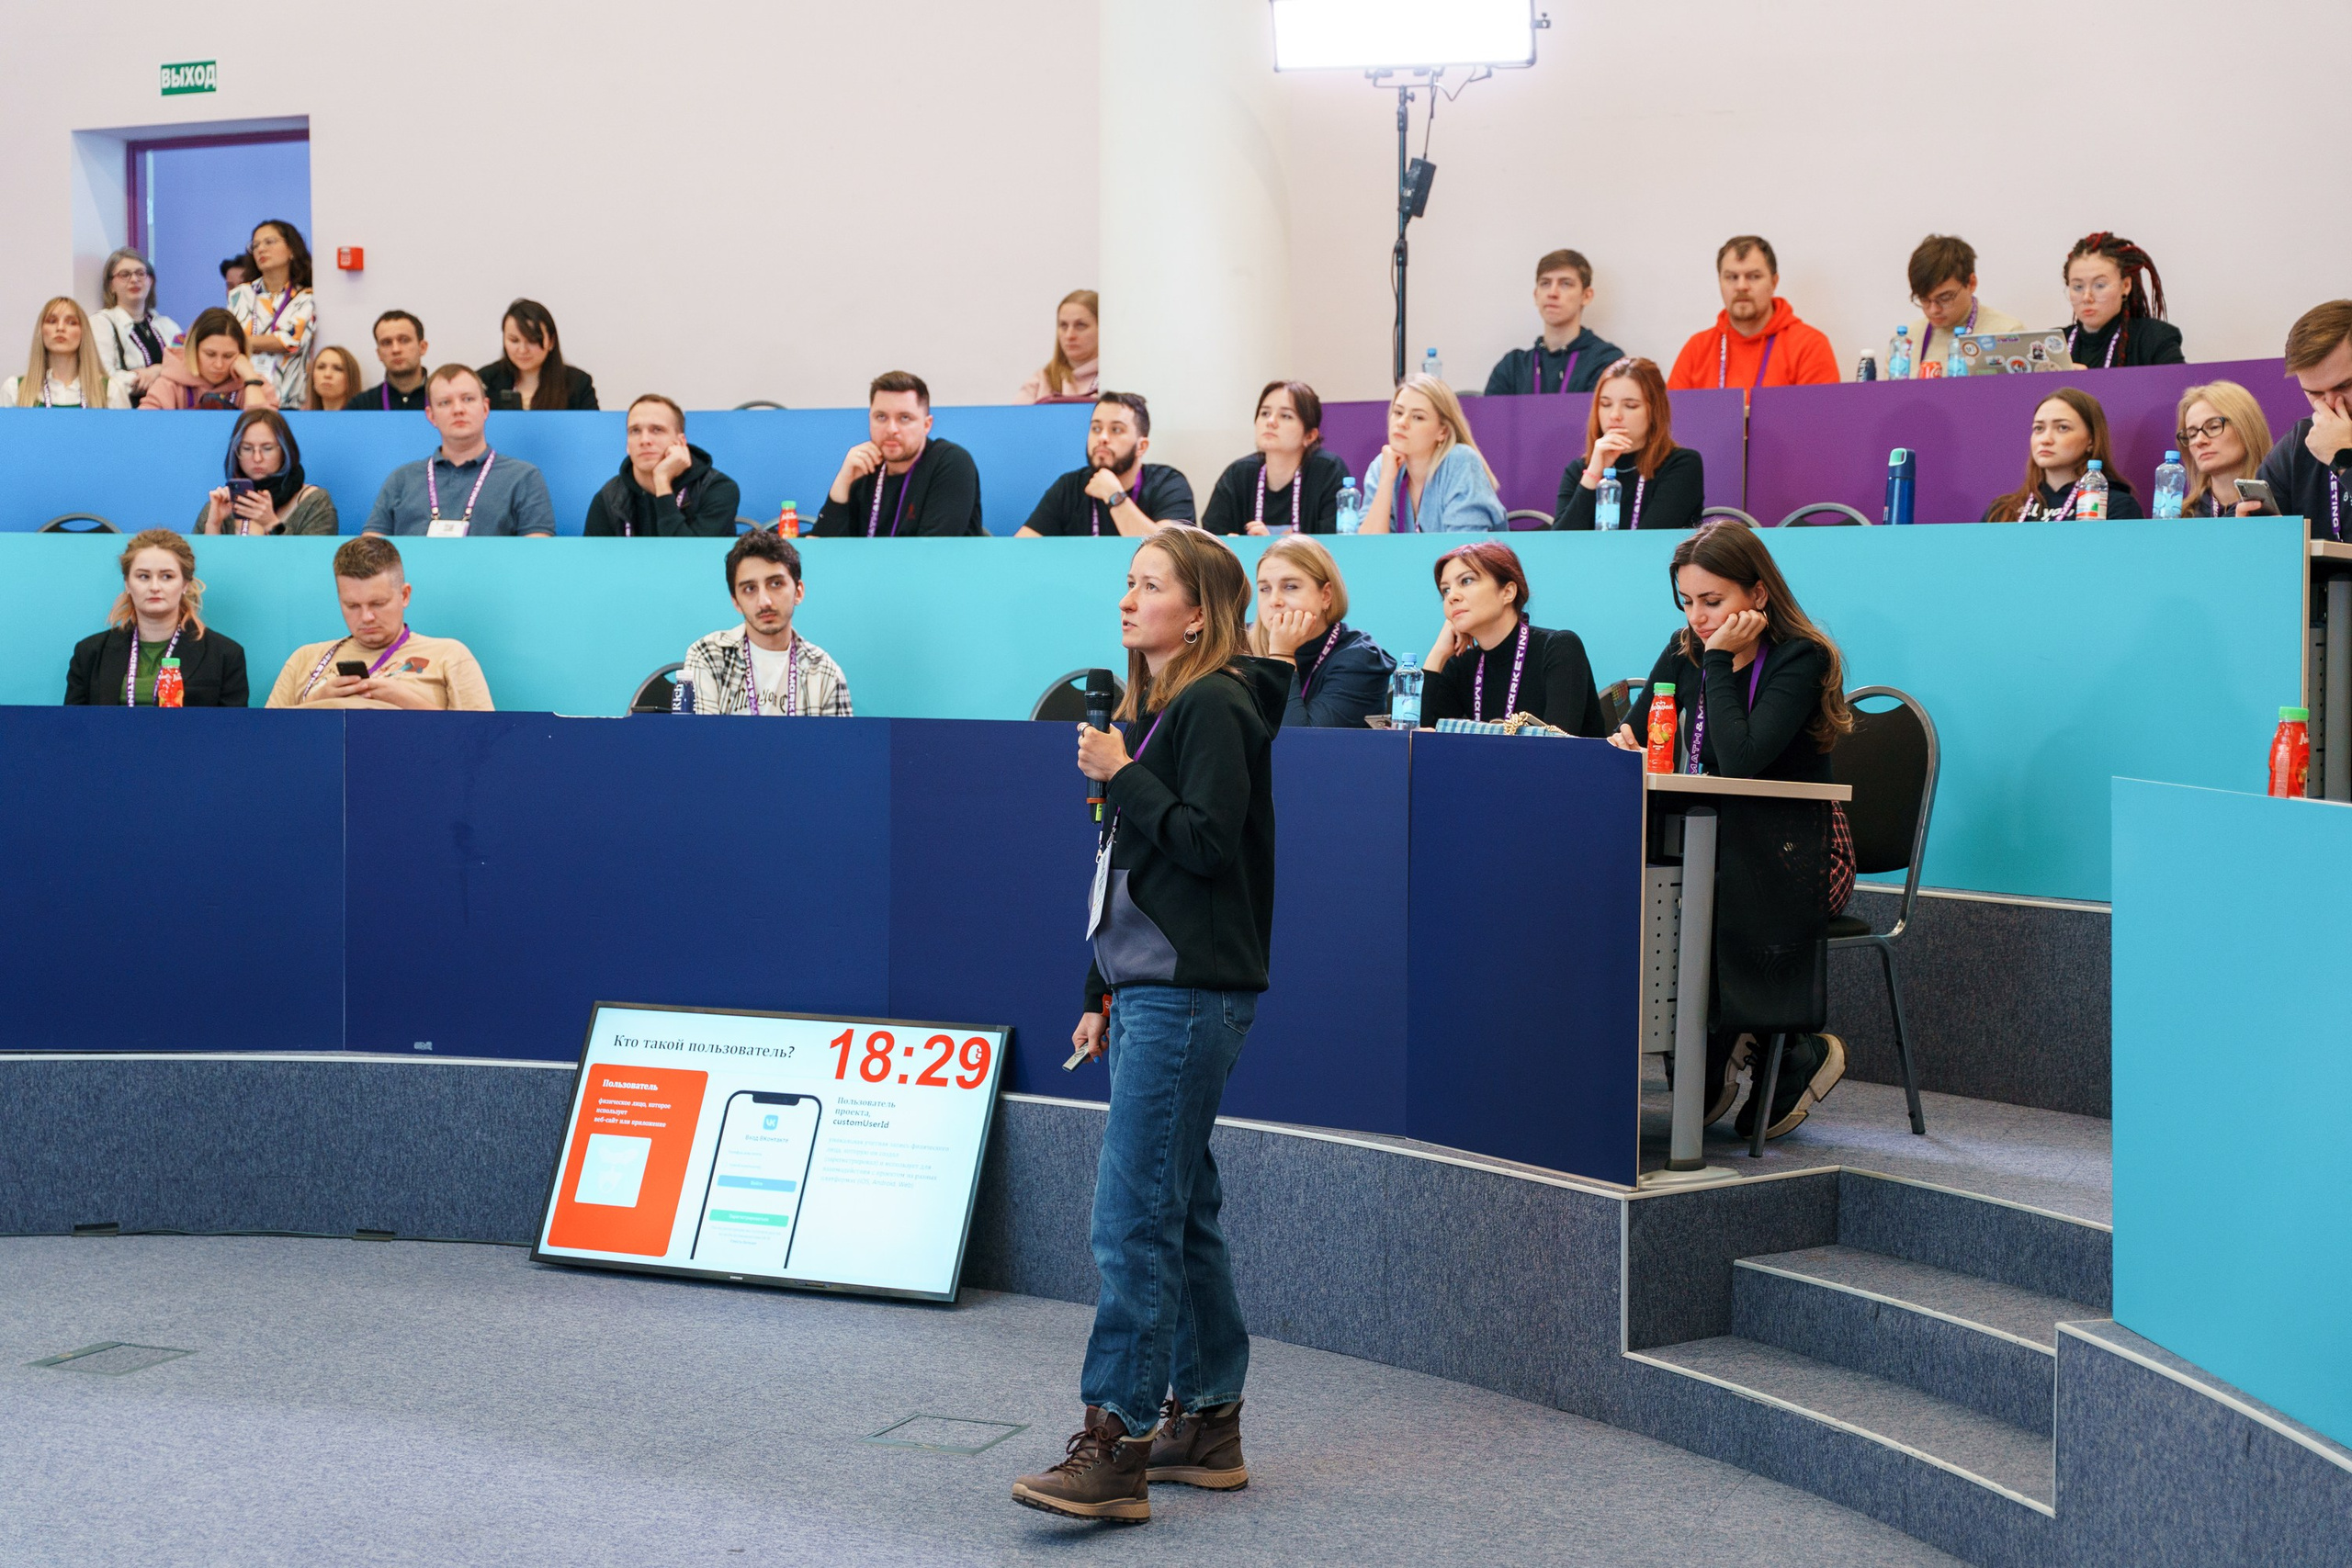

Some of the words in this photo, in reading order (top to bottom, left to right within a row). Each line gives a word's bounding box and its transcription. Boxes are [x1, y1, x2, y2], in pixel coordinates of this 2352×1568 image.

[161, 64, 216, 89] ВЫХОД
[1505, 626, 1529, 722] MARKETING
[672, 683, 684, 711] Rich
[613, 1034, 639, 1048] Кто
[643, 1038, 684, 1052] такой
[688, 1041, 796, 1059] пользователь?
[829, 1028, 991, 1090] 18:29
[603, 1078, 659, 1091] Пользователь
[598, 1098, 631, 1106] физическое
[837, 1096, 896, 1109] Пользователь
[834, 1108, 871, 1118] проекта,
[594, 1116, 618, 1124] веб-сайт
[832, 1118, 890, 1129] customUserId
